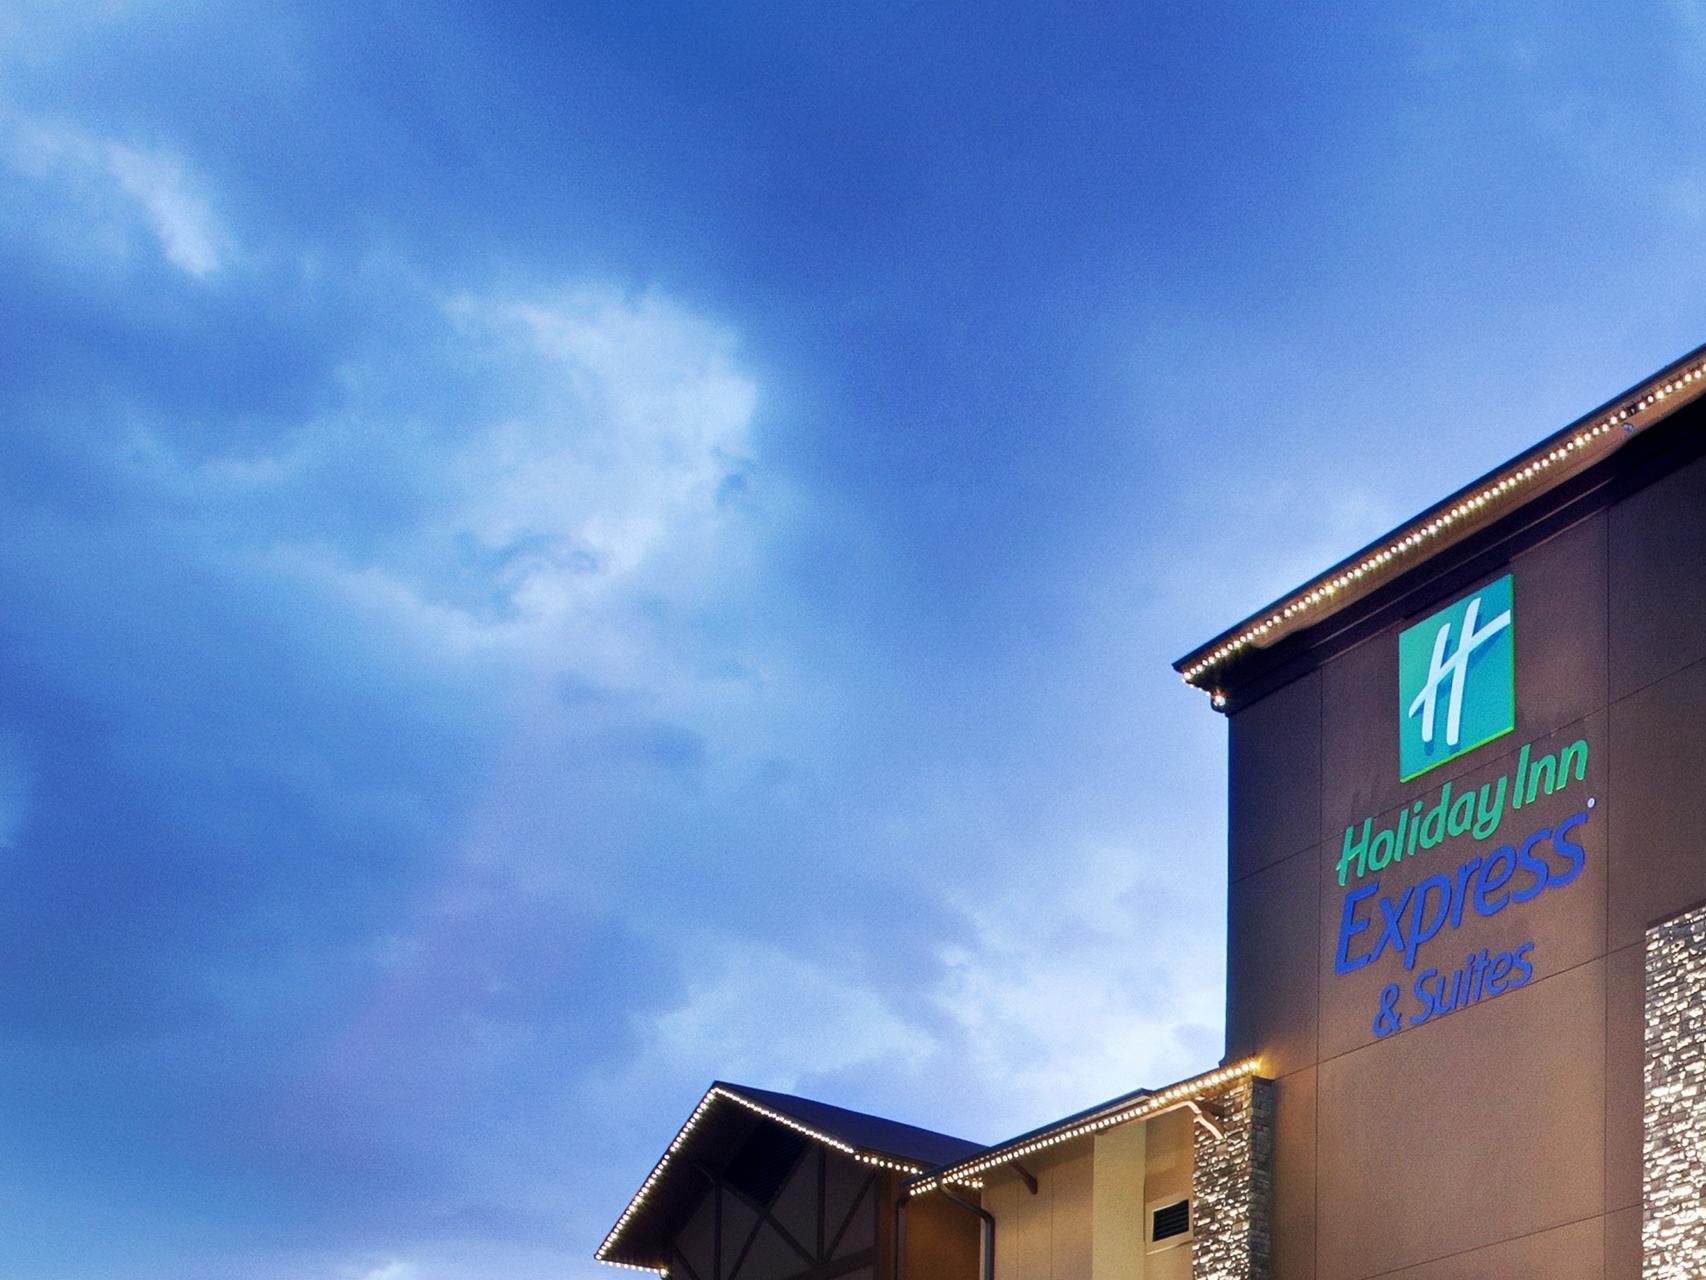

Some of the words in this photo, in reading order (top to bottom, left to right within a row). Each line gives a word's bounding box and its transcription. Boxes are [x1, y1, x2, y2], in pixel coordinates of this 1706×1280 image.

[1335, 774, 1507, 886] Holiday
[1512, 739, 1589, 810] Inn
[1334, 812, 1589, 976] Express
[1371, 983, 1401, 1038] &
[1408, 943, 1535, 1025] Suites
